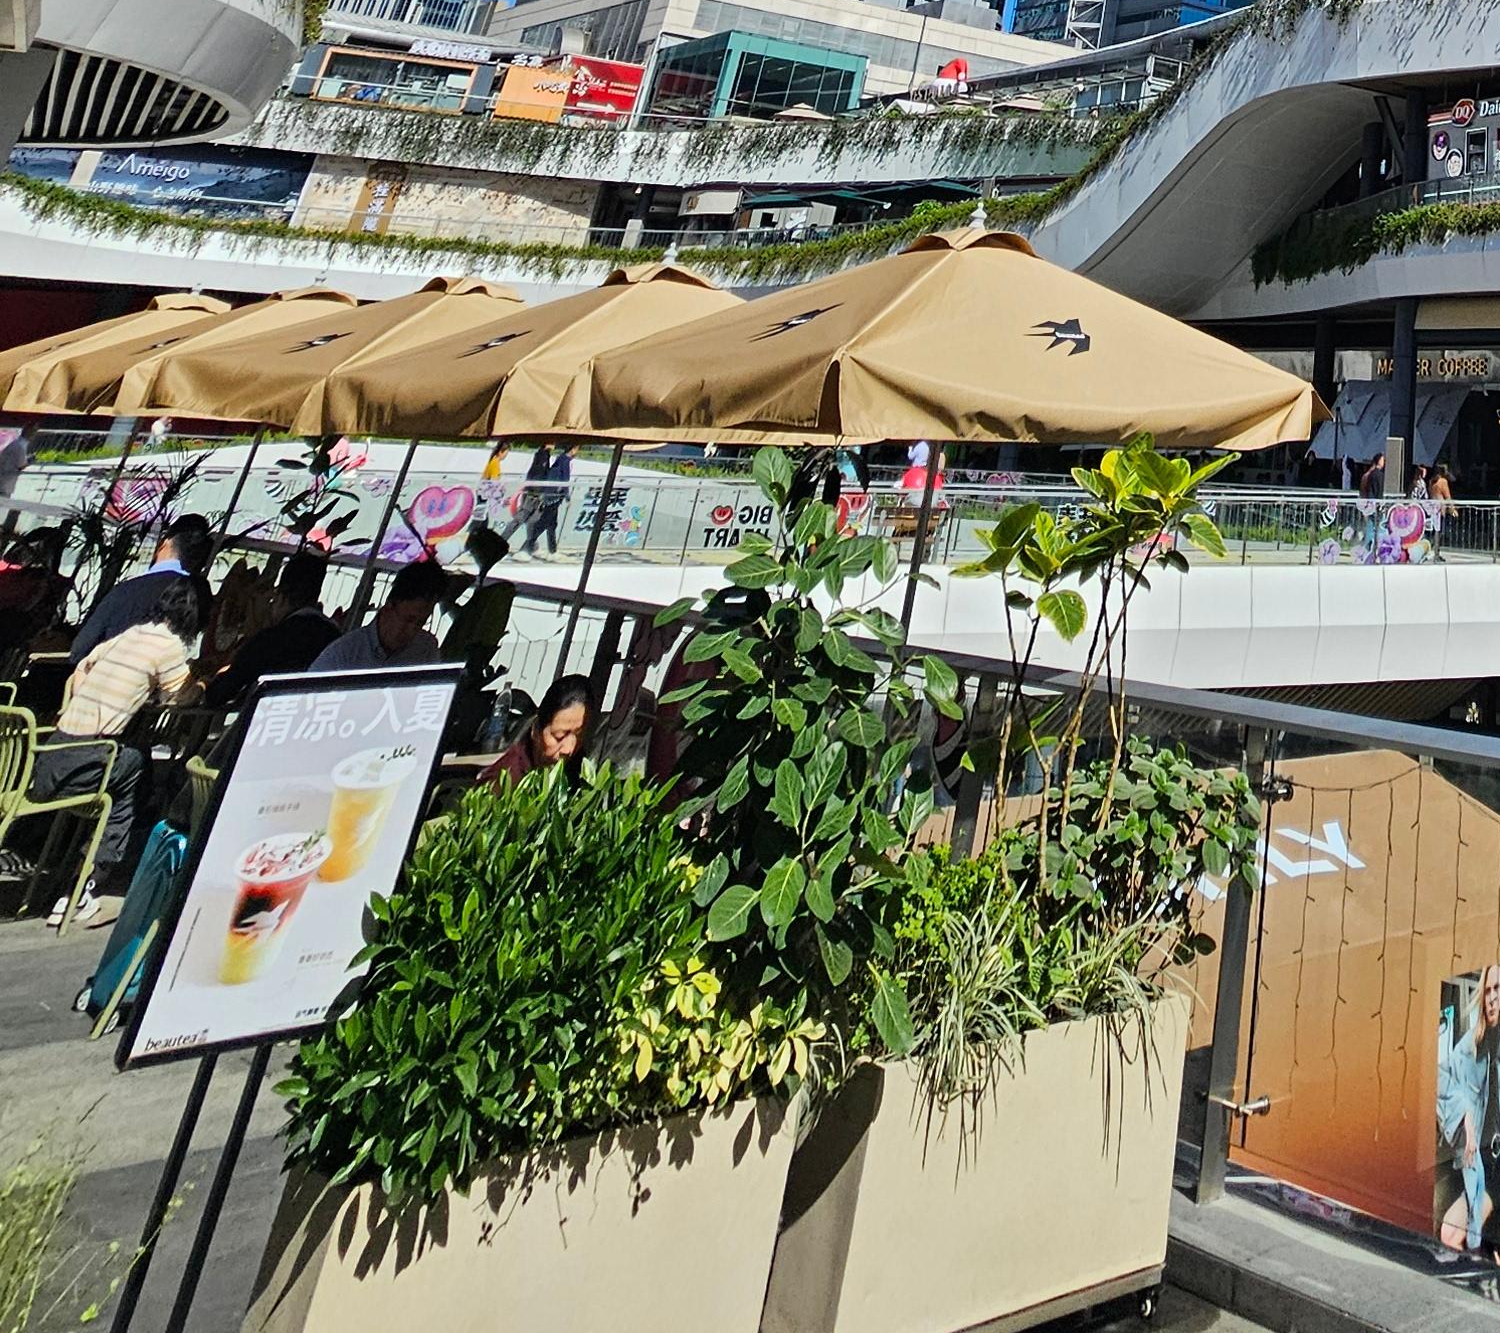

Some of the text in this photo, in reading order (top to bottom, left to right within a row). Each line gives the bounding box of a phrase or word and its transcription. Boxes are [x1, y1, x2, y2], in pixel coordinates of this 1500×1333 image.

[1455, 105, 1471, 119] DQ
[1377, 357, 1489, 376] MAER COFFEE
[144, 1032, 198, 1052] beautea
